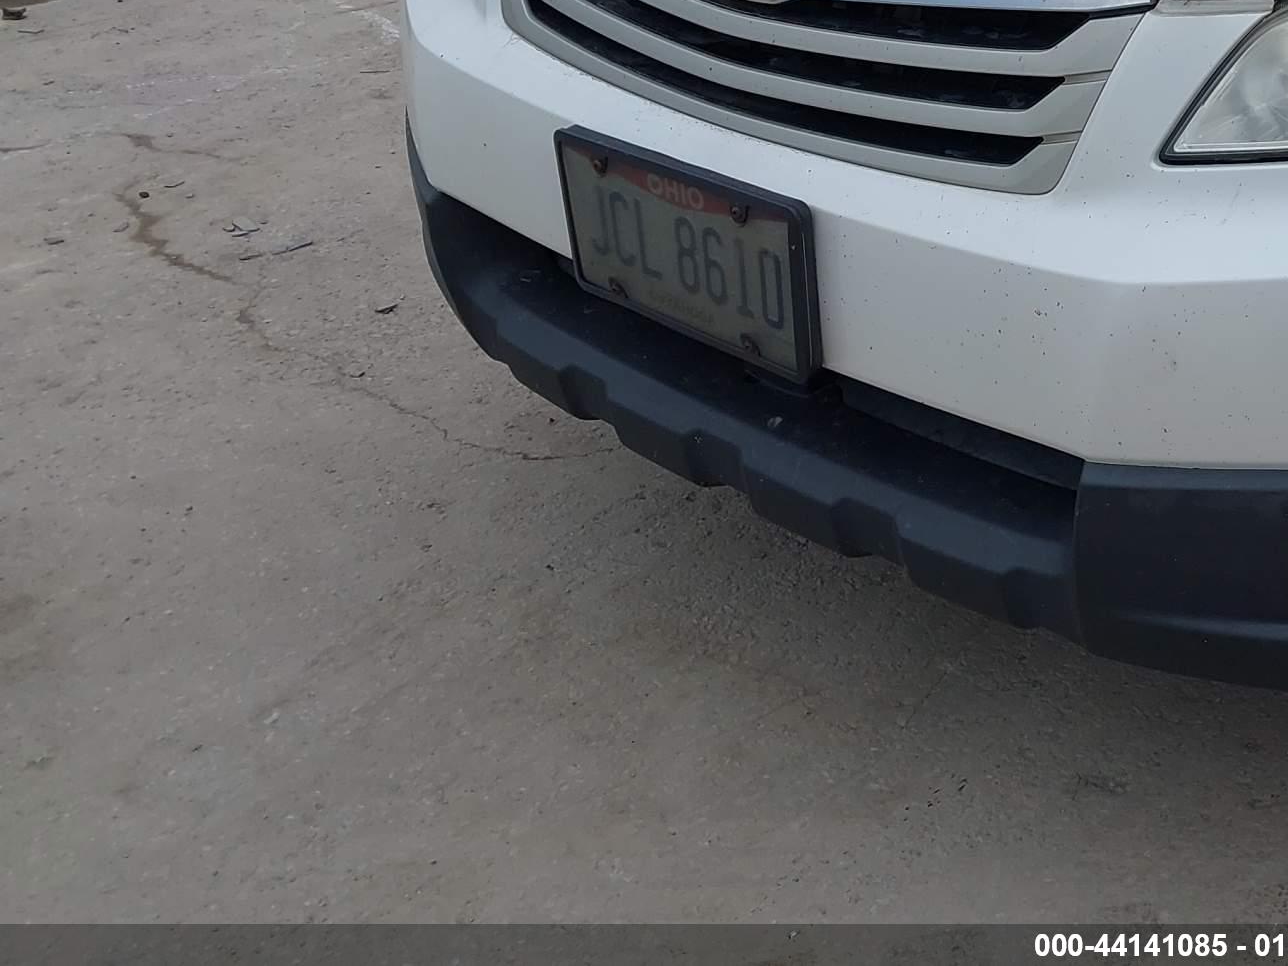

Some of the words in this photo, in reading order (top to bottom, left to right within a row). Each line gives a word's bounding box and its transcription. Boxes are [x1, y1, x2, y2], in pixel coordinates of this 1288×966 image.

[646, 173, 705, 211] OHIO
[590, 184, 663, 282] JCL
[674, 215, 786, 330] 8610
